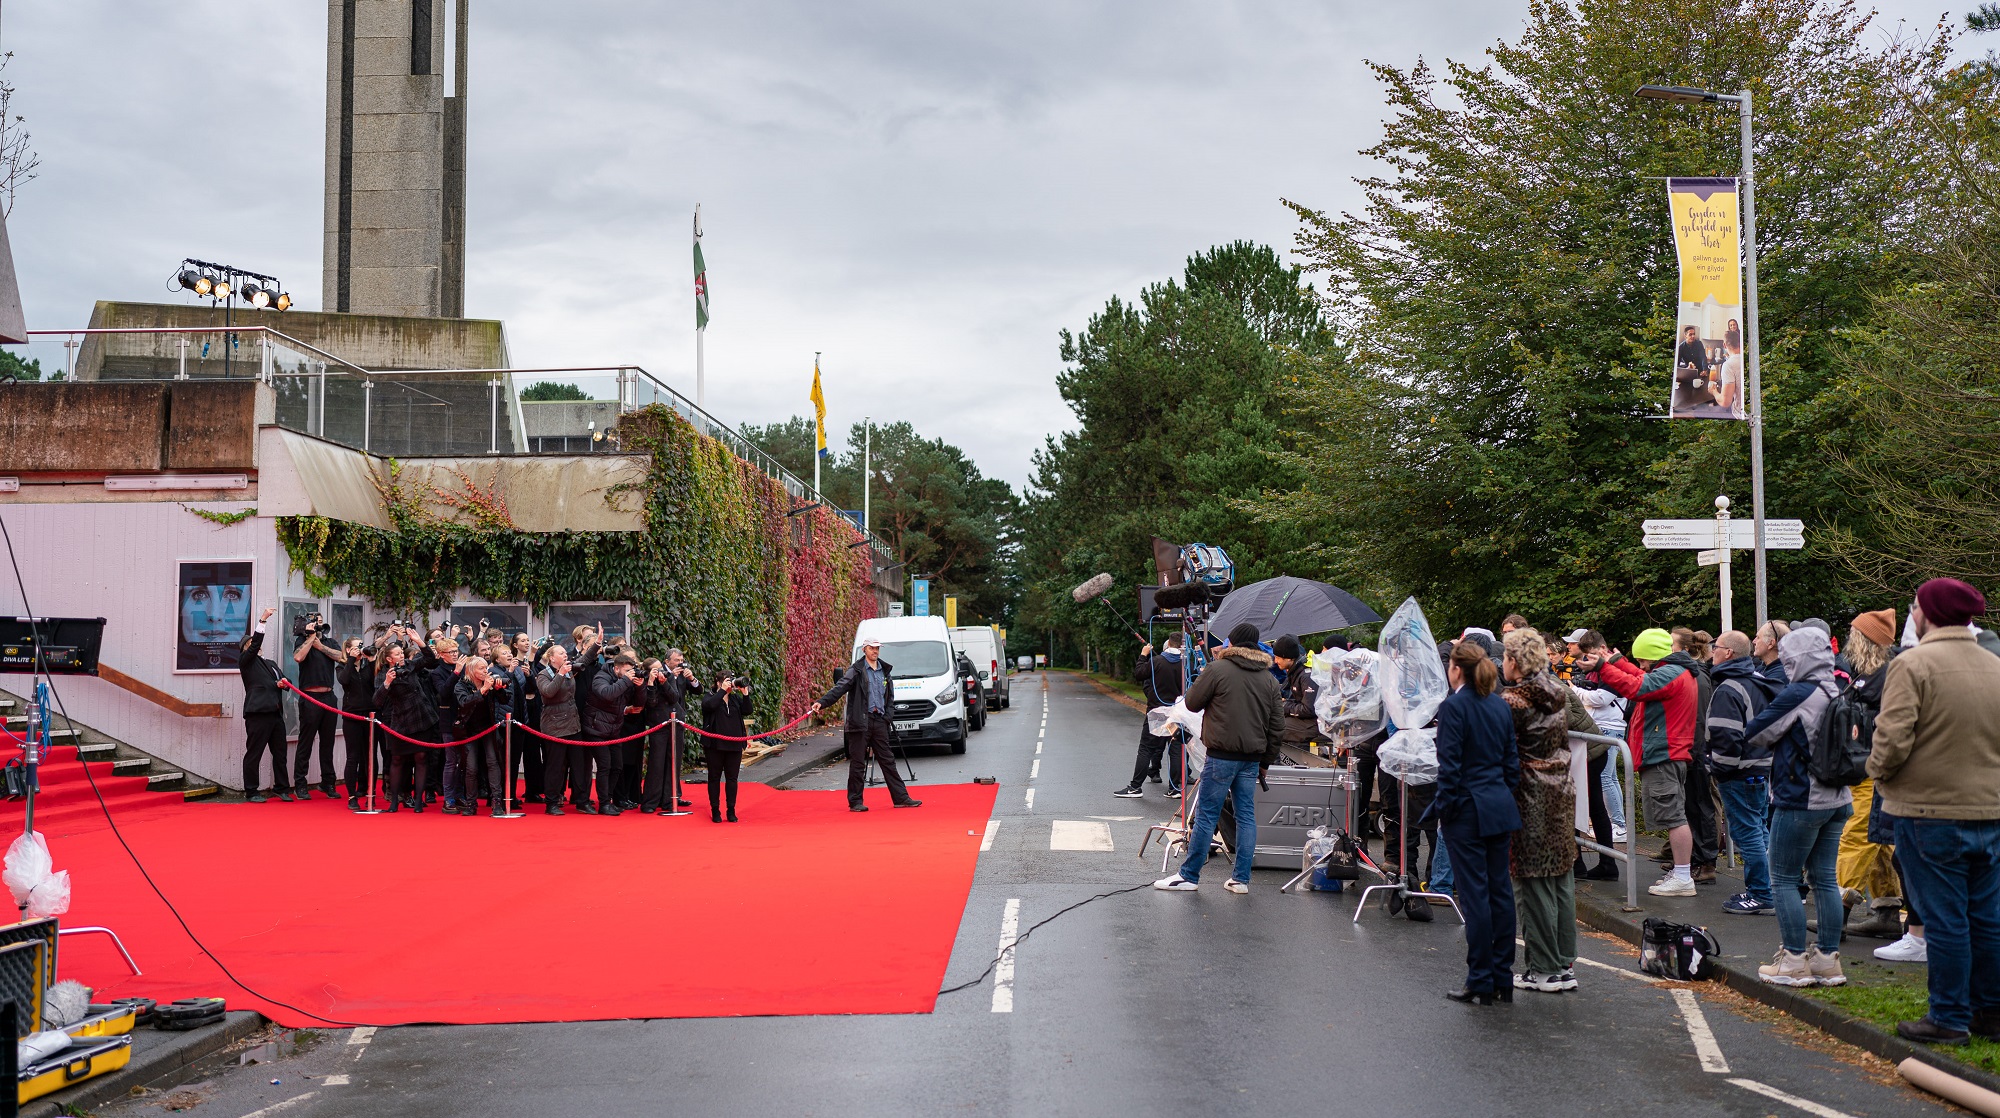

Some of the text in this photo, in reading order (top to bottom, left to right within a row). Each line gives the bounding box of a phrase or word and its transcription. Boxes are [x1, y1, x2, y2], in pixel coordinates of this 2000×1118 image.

[1689, 206, 1726, 224] Gyda'n
[1681, 220, 1732, 239] gilydd yn
[1701, 235, 1720, 248] Aber
[1269, 805, 1332, 827] ARRI
